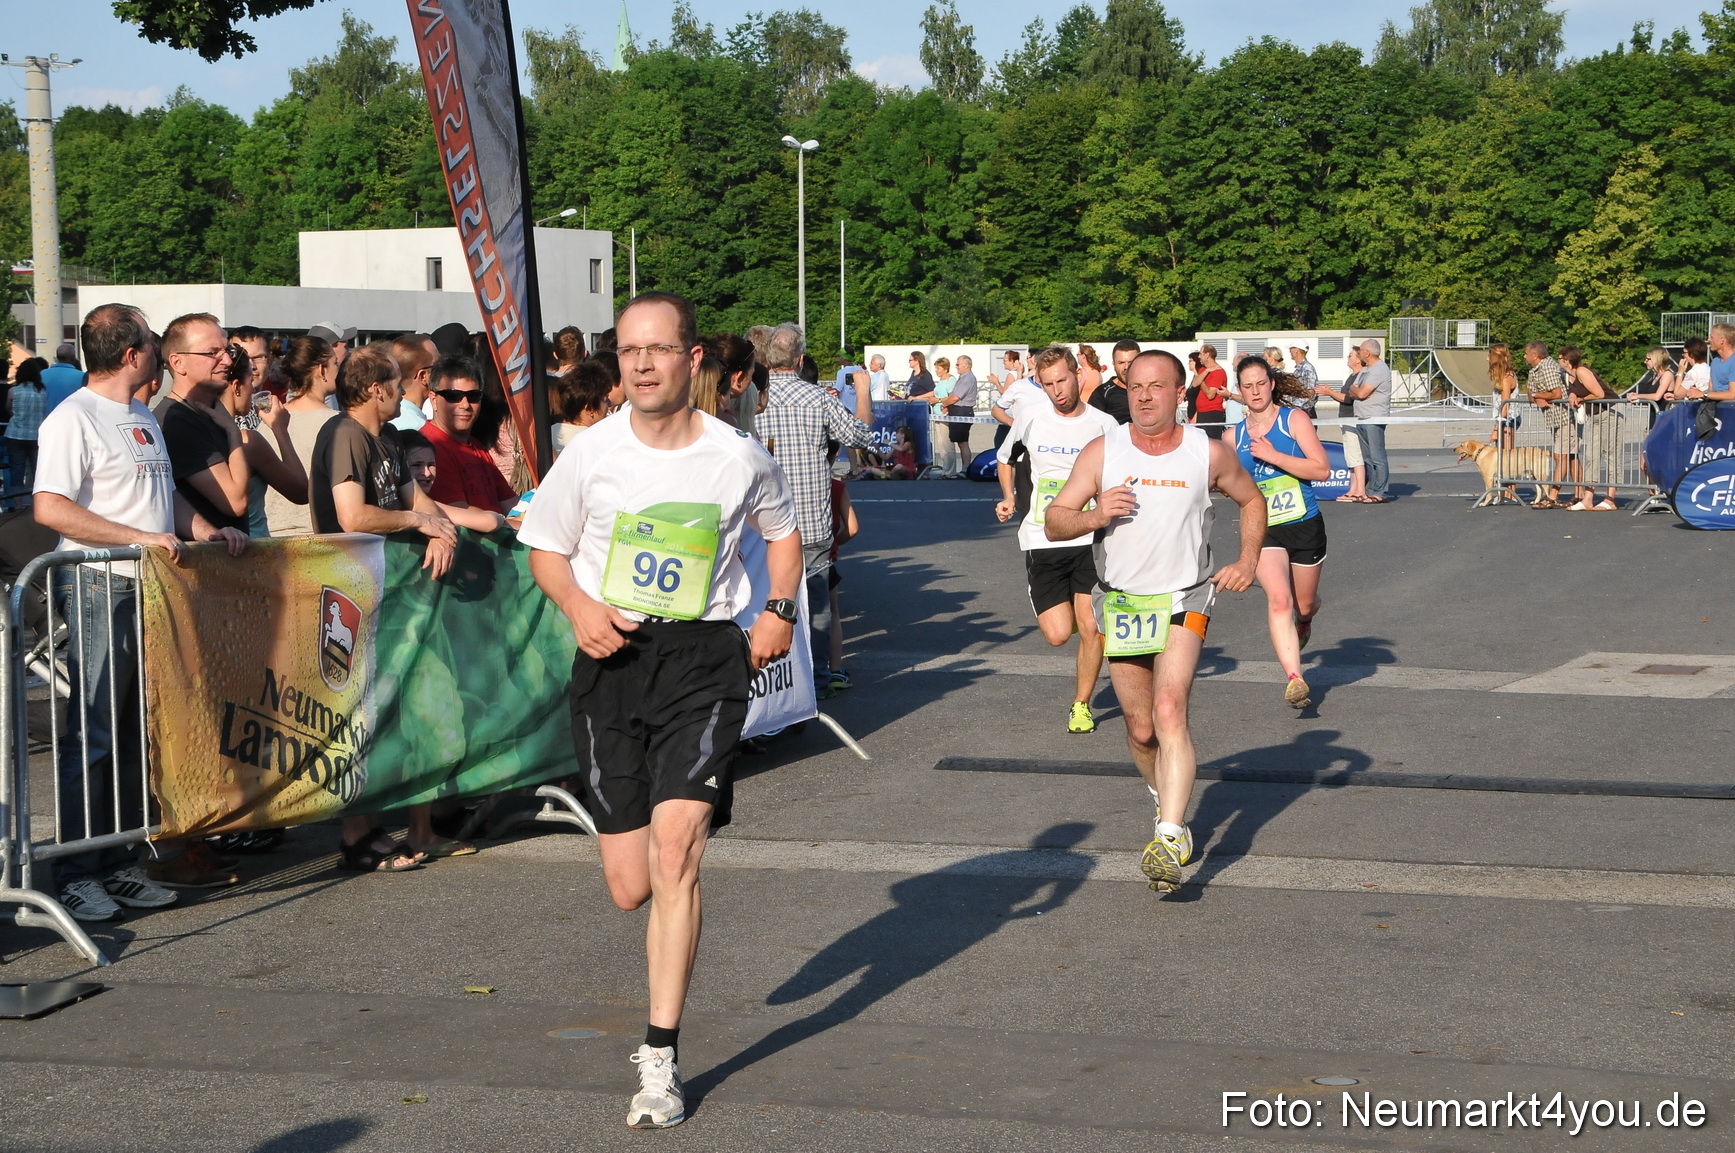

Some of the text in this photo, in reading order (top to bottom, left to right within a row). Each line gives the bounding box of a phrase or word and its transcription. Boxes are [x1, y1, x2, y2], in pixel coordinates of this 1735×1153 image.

[1141, 478, 1190, 489] KLEBL
[632, 551, 684, 594] 96
[633, 588, 655, 599] Thomas
[1115, 613, 1158, 640] 511
[325, 661, 343, 683] 1628
